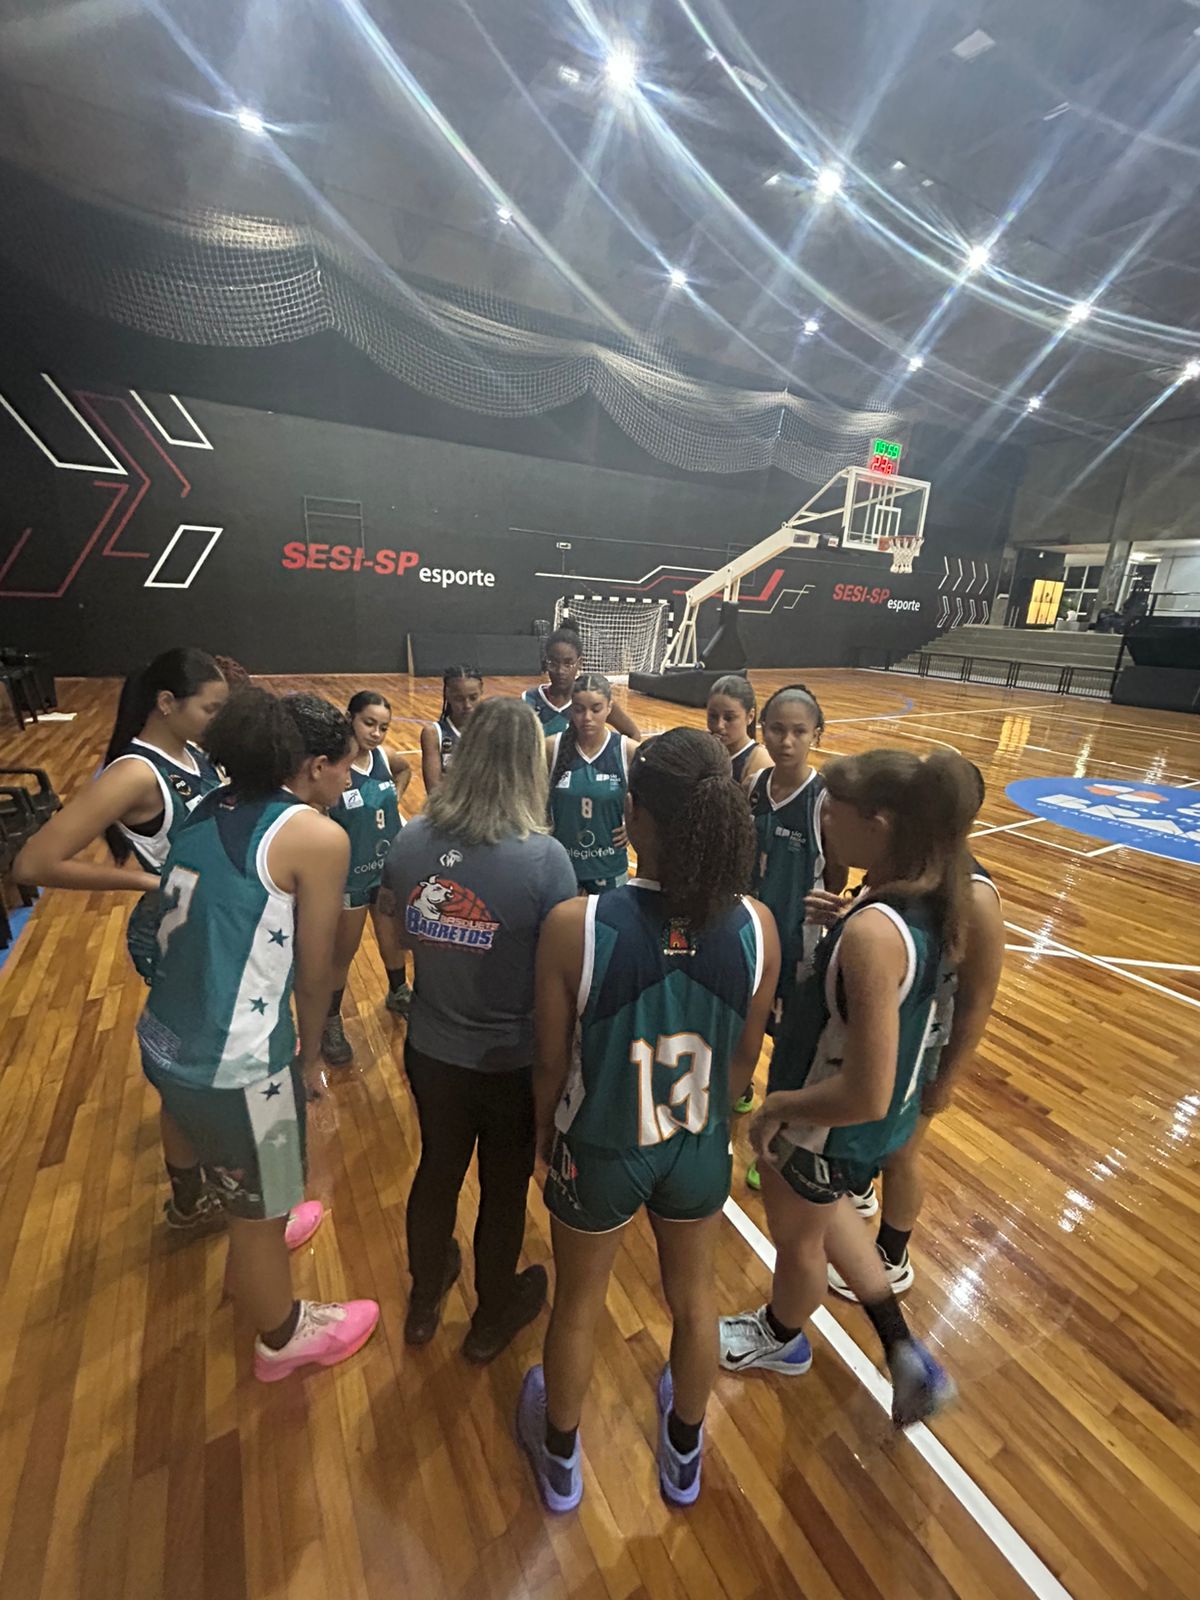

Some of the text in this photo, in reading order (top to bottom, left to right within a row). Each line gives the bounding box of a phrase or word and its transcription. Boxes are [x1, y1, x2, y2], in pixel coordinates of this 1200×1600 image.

[281, 541, 496, 588] SESI-SP esporte
[832, 583, 921, 612] SESI-SP esporte
[376, 809, 386, 830] 9
[581, 797, 593, 819] 8
[405, 905, 494, 947] BARRETOS
[630, 1032, 712, 1147] 13
